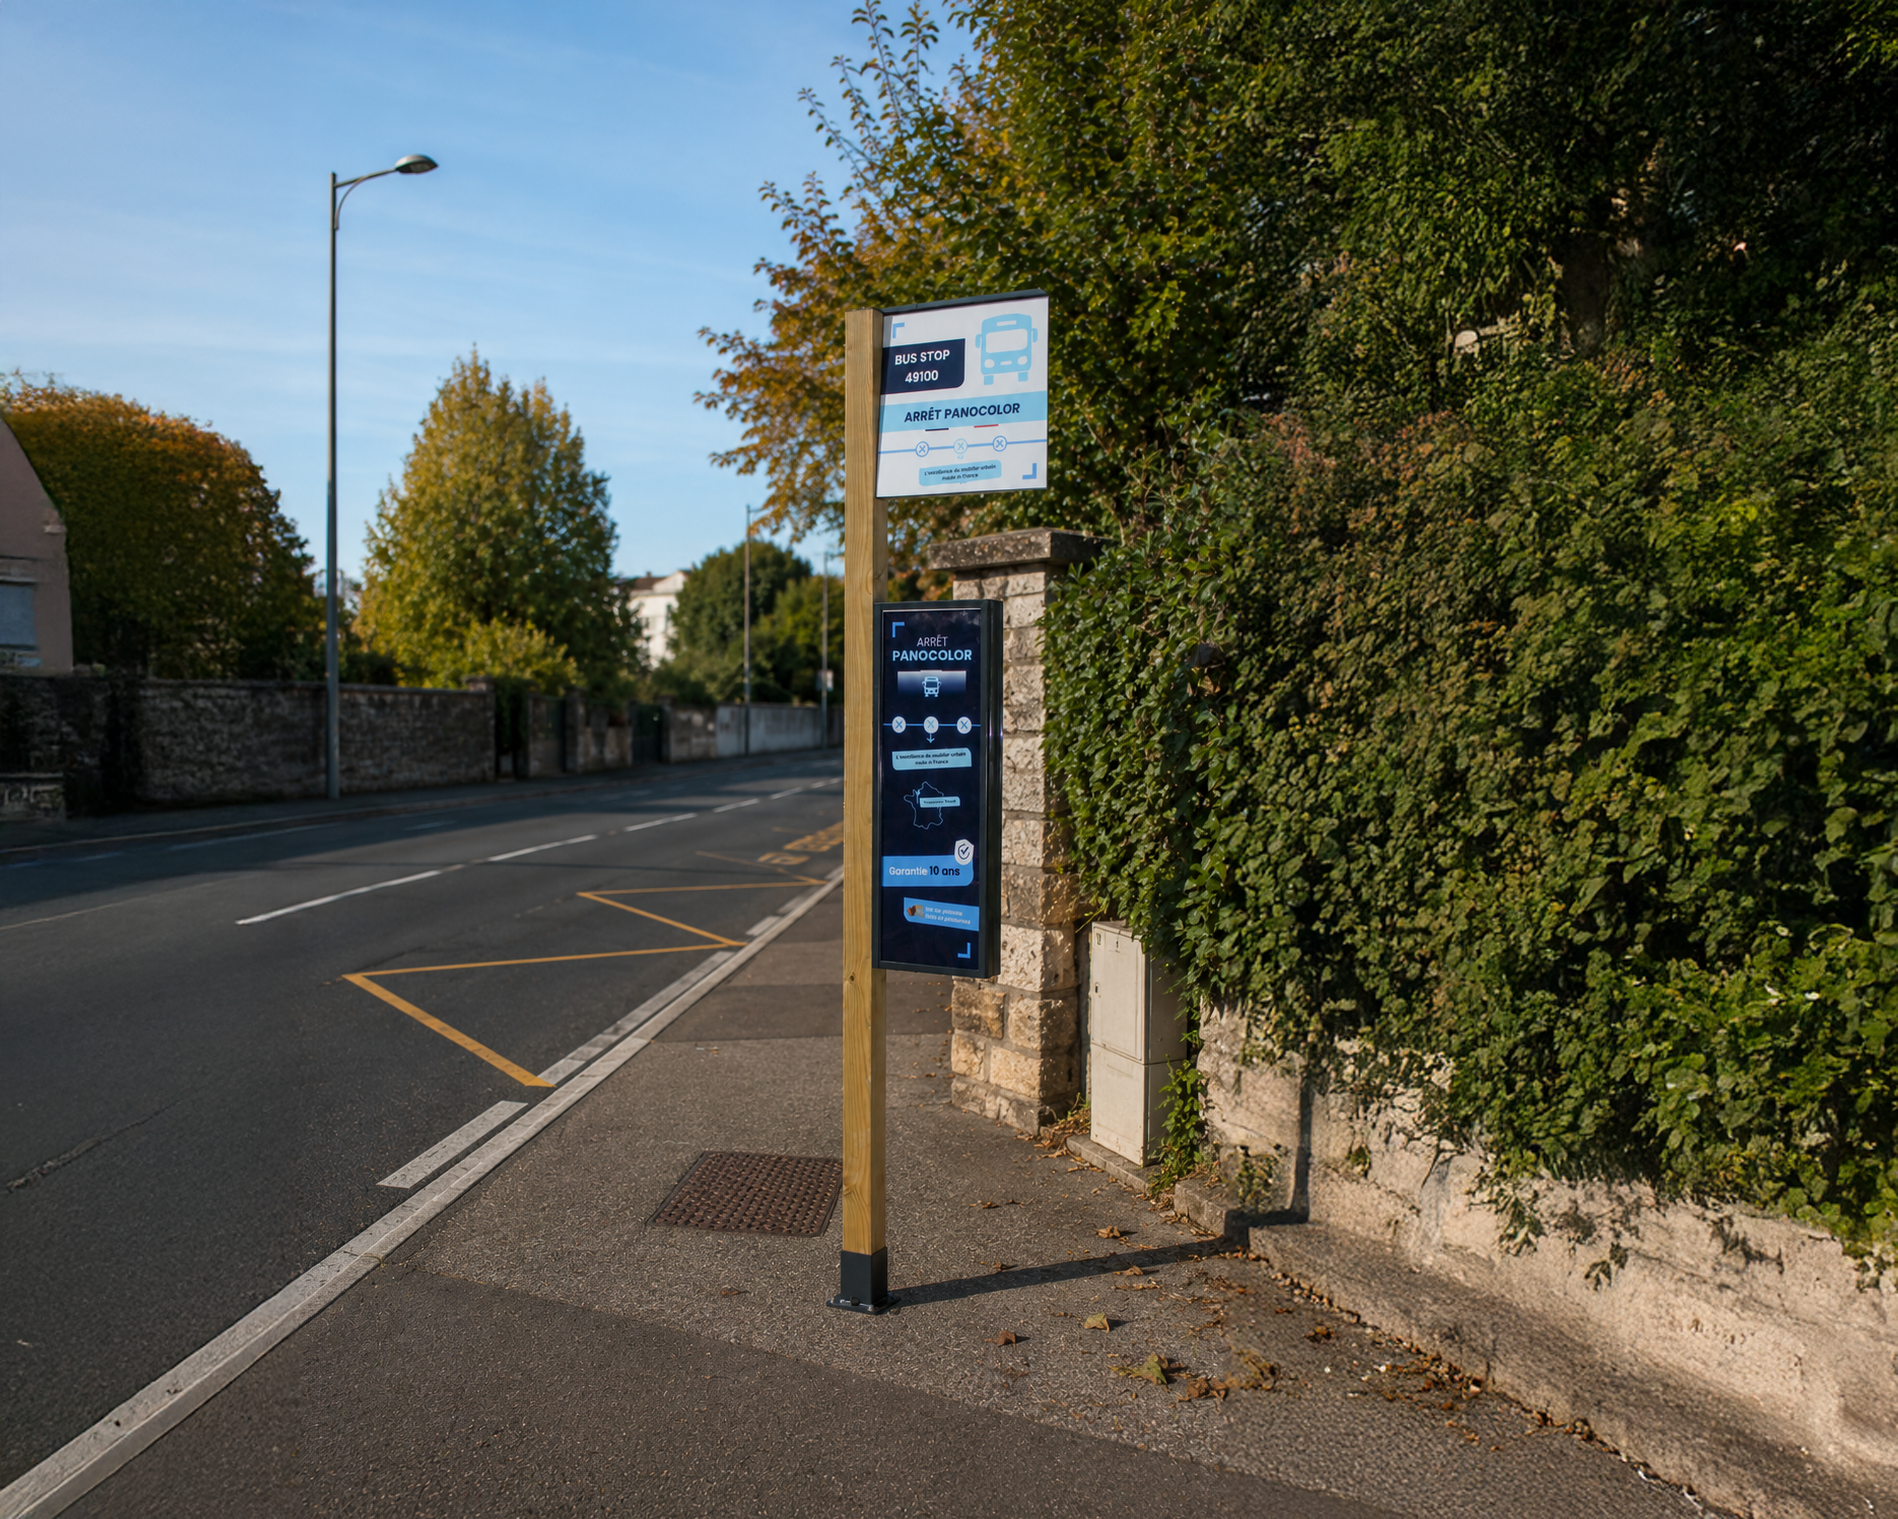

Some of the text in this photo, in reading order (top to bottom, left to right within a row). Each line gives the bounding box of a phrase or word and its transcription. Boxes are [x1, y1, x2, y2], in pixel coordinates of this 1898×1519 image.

[894, 349, 951, 366] BUS STOP
[904, 370, 939, 383] 49100
[904, 403, 1021, 422] ARRÊT PANOCOLOR
[916, 634, 948, 647] ARRÊT
[892, 649, 973, 661] PANOCOLOR
[888, 865, 961, 876] Garantie 10 ans
